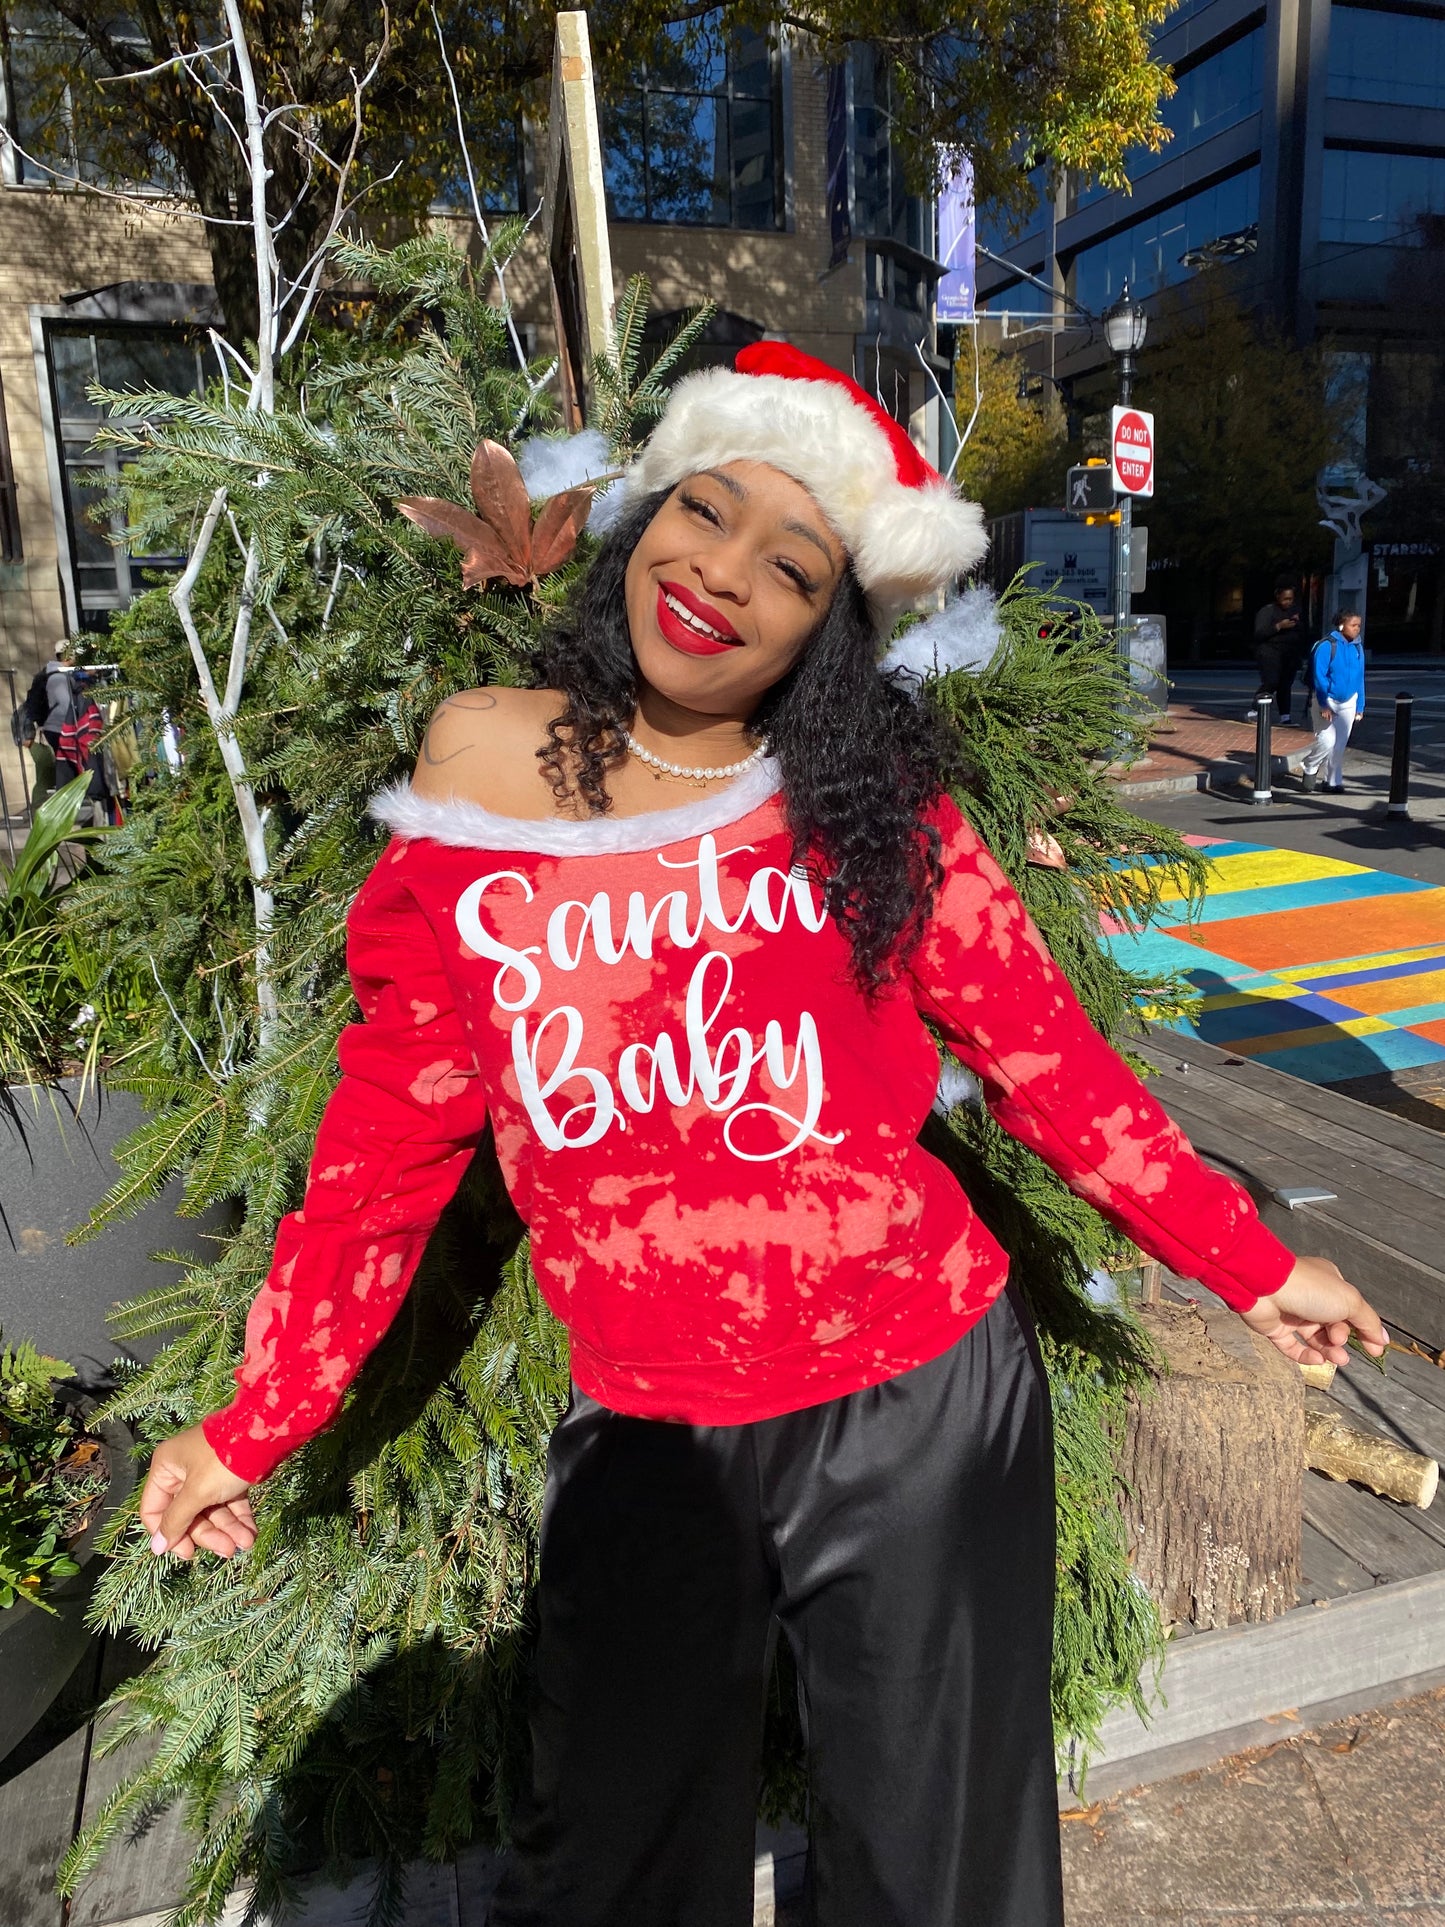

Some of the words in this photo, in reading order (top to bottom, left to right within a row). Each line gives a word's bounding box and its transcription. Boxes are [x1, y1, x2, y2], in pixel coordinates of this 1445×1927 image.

[1121, 425, 1131, 440] DO
[1134, 428, 1148, 444] NOT
[1122, 461, 1145, 478] ENTER
[455, 834, 829, 1011] Santa
[511, 951, 845, 1161] Baby
